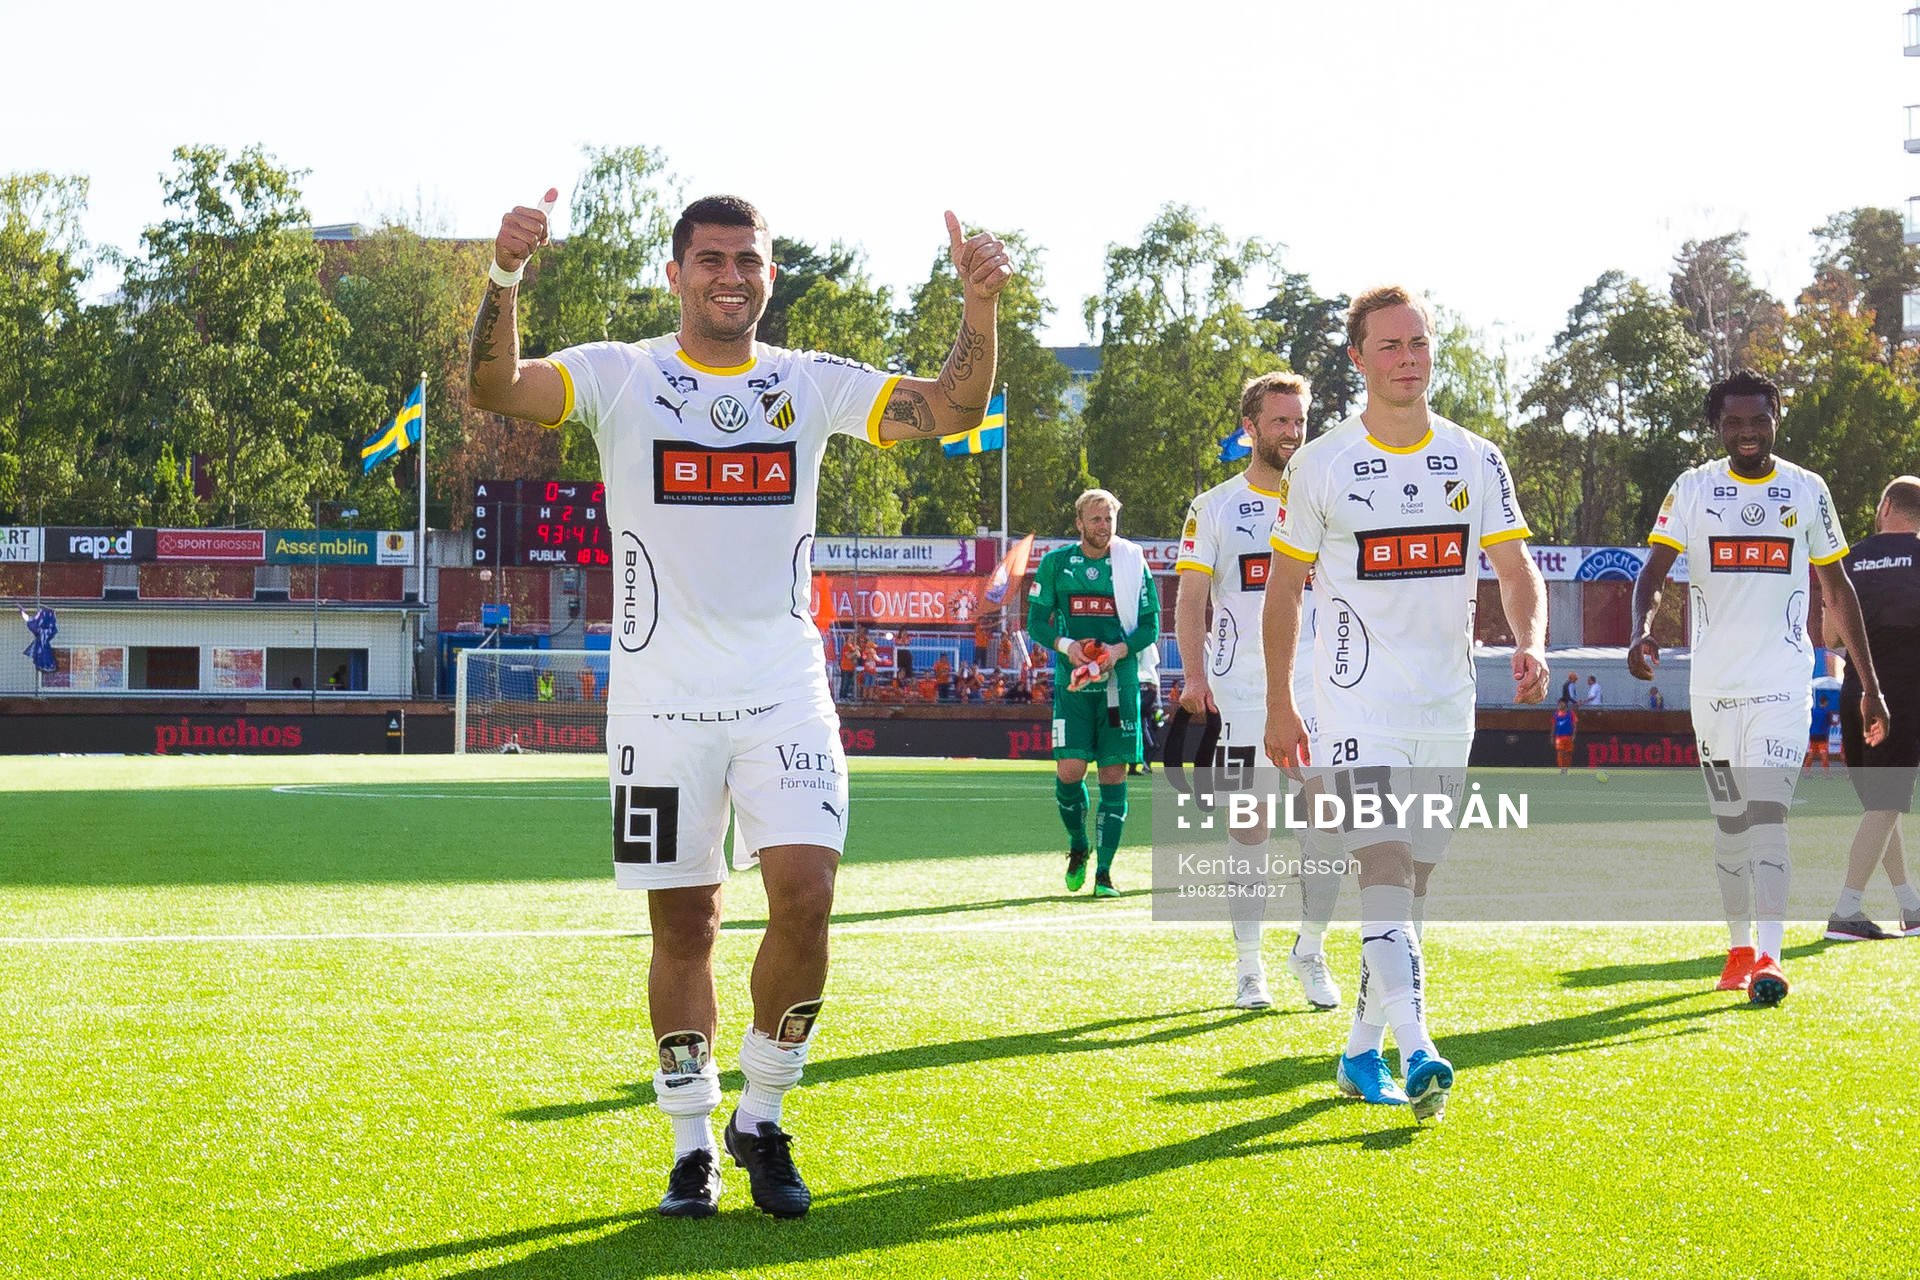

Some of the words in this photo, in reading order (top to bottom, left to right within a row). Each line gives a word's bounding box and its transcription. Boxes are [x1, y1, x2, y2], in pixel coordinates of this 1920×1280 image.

[675, 462, 786, 482] BRA
[477, 485, 488, 497] A
[476, 506, 486, 518] B
[540, 507, 551, 519] H
[562, 505, 574, 521] 2
[586, 508, 596, 520] B
[476, 527, 487, 539] C
[275, 538, 368, 555] Assemblin
[476, 549, 486, 560] D
[827, 544, 840, 558] Vi
[845, 545, 900, 559] tacklar
[903, 545, 933, 559] allt!
[1373, 541, 1461, 561] BRA
[1719, 547, 1785, 560] BRA
[529, 550, 566, 561] PUBLIK
[1853, 555, 1912, 571] stadium
[623, 551, 637, 635] BOHUS
[858, 590, 945, 618] TOWERS
[1073, 600, 1113, 609] BRA
[1215, 618, 1228, 667] BOHUS
[1336, 611, 1350, 675] BOHUS
[155, 717, 302, 754] pinchos
[1332, 738, 1359, 766] 28
[1587, 735, 1700, 768] pincho
